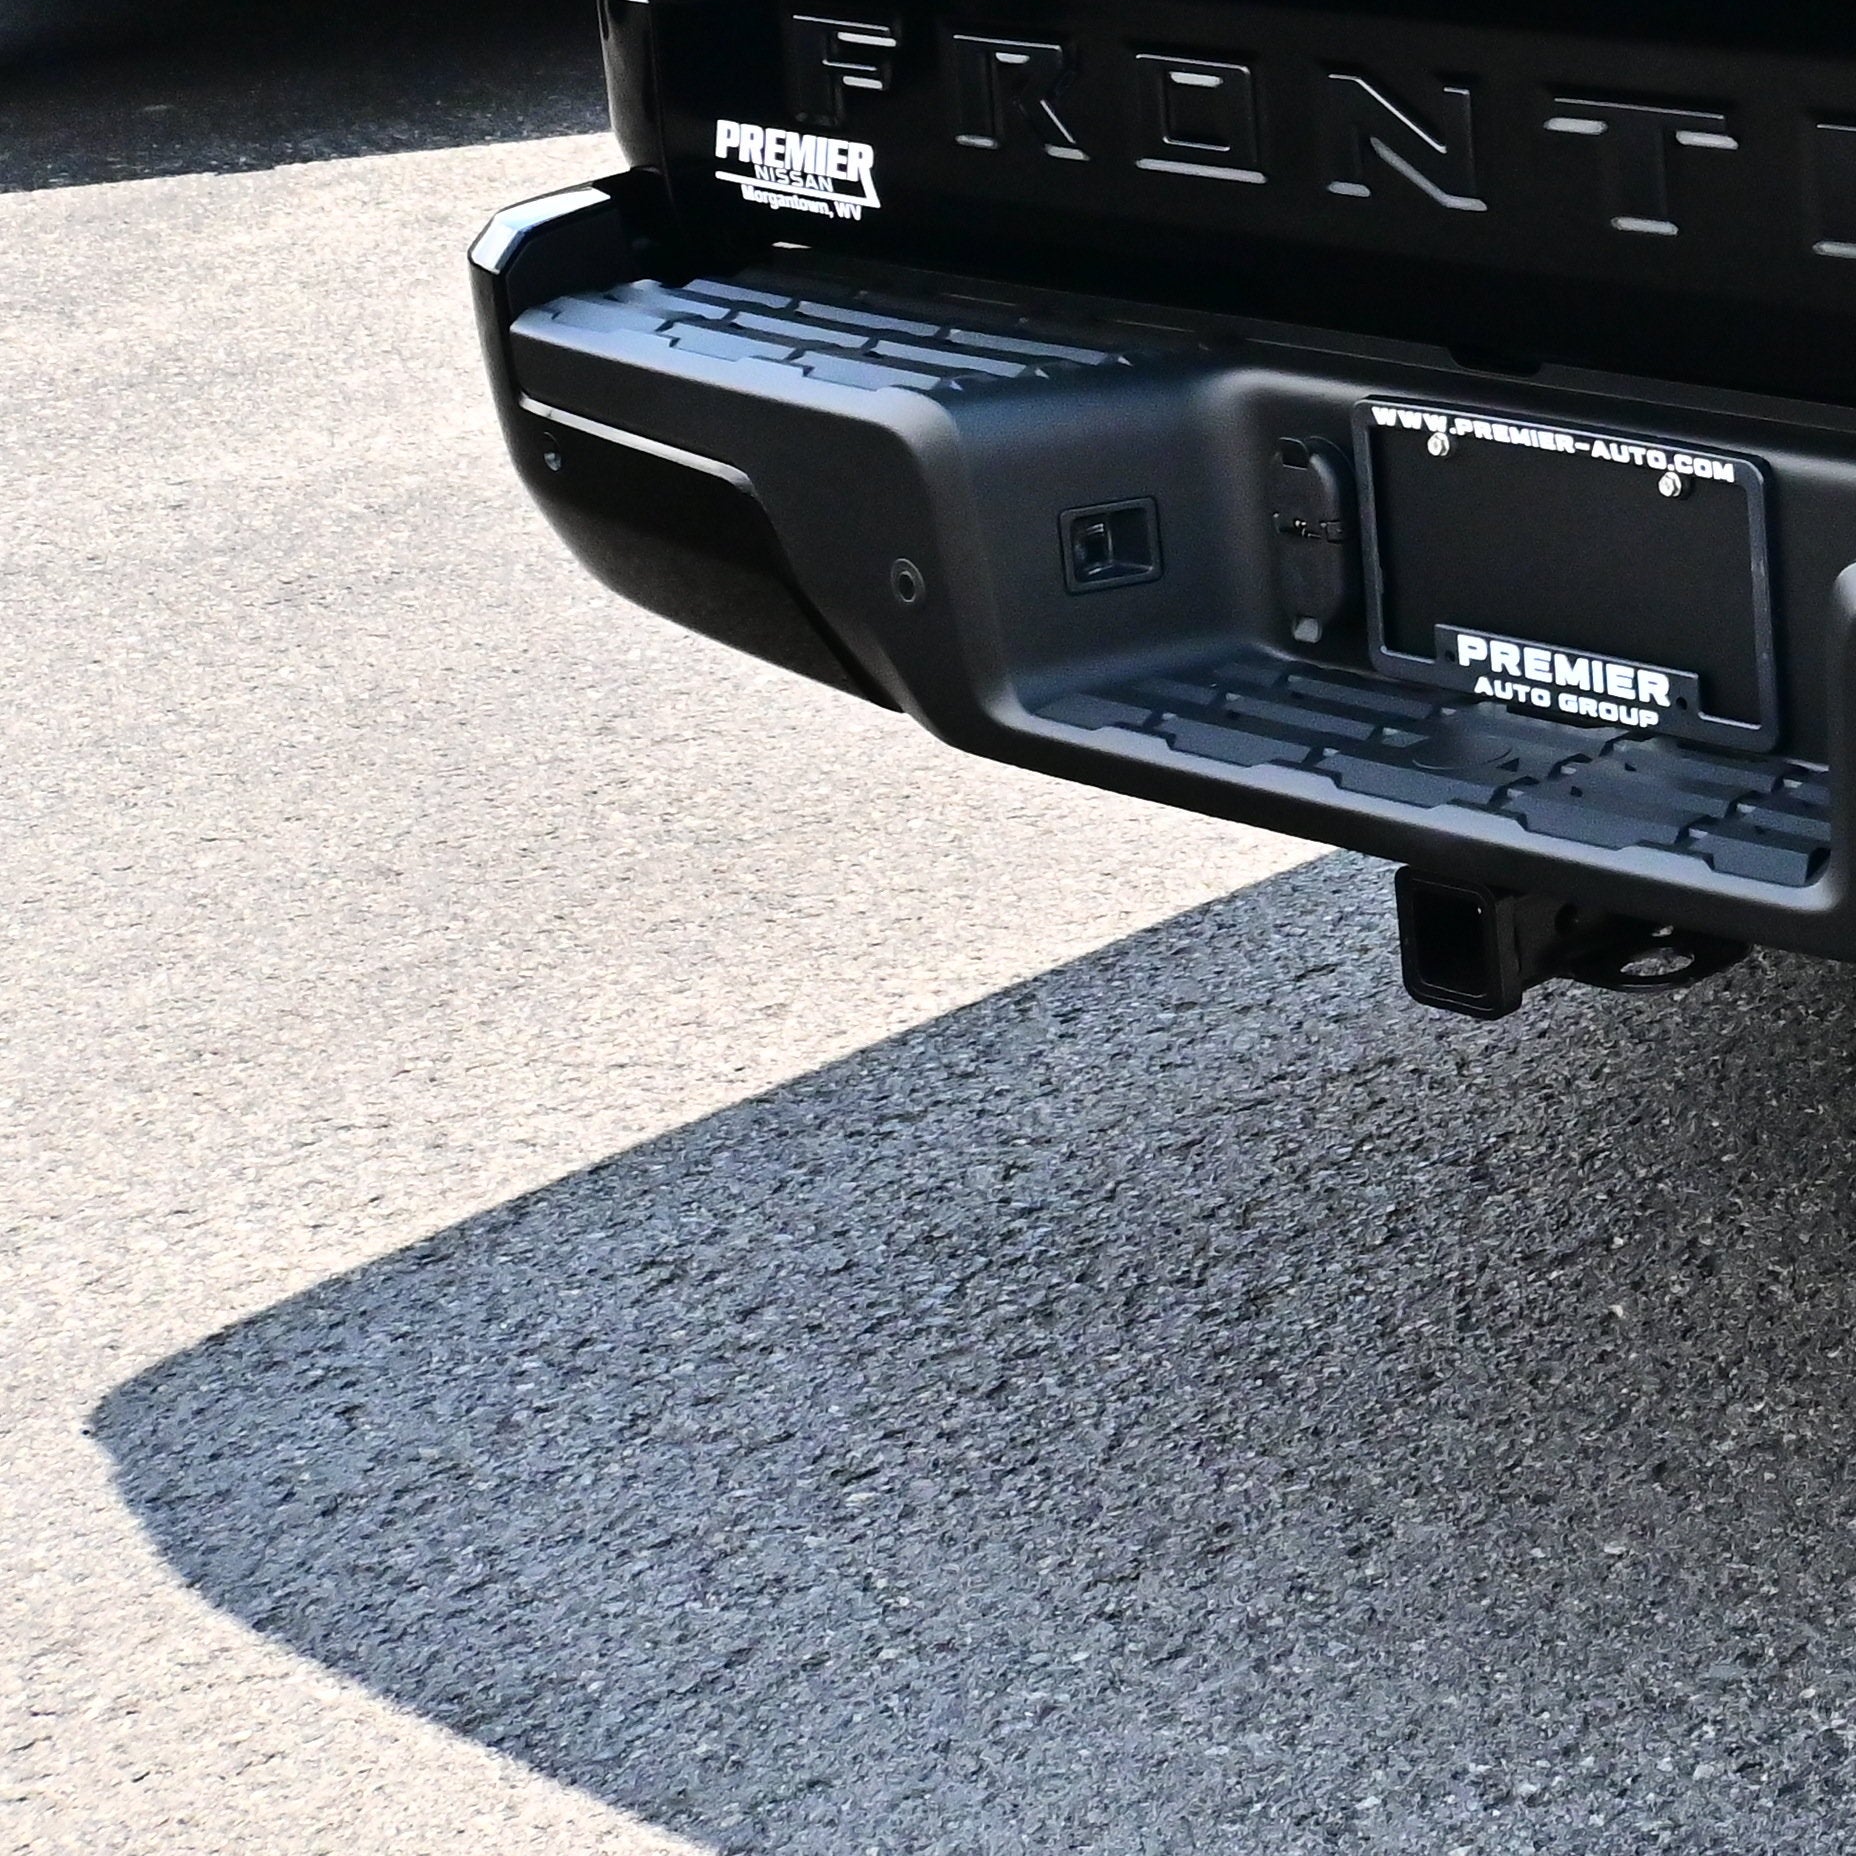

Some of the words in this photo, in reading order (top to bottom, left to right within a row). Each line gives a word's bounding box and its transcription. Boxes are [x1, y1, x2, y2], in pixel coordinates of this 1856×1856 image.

[715, 119, 876, 186] PREMIER
[754, 164, 834, 193] NISSAN
[834, 200, 862, 221] WV
[1371, 406, 1735, 483] WWW.PREMIER-AUTO.COM
[1456, 633, 1671, 708] PREMIER
[1473, 676, 1551, 708] AUTO
[1558, 693, 1660, 728] GROUP
